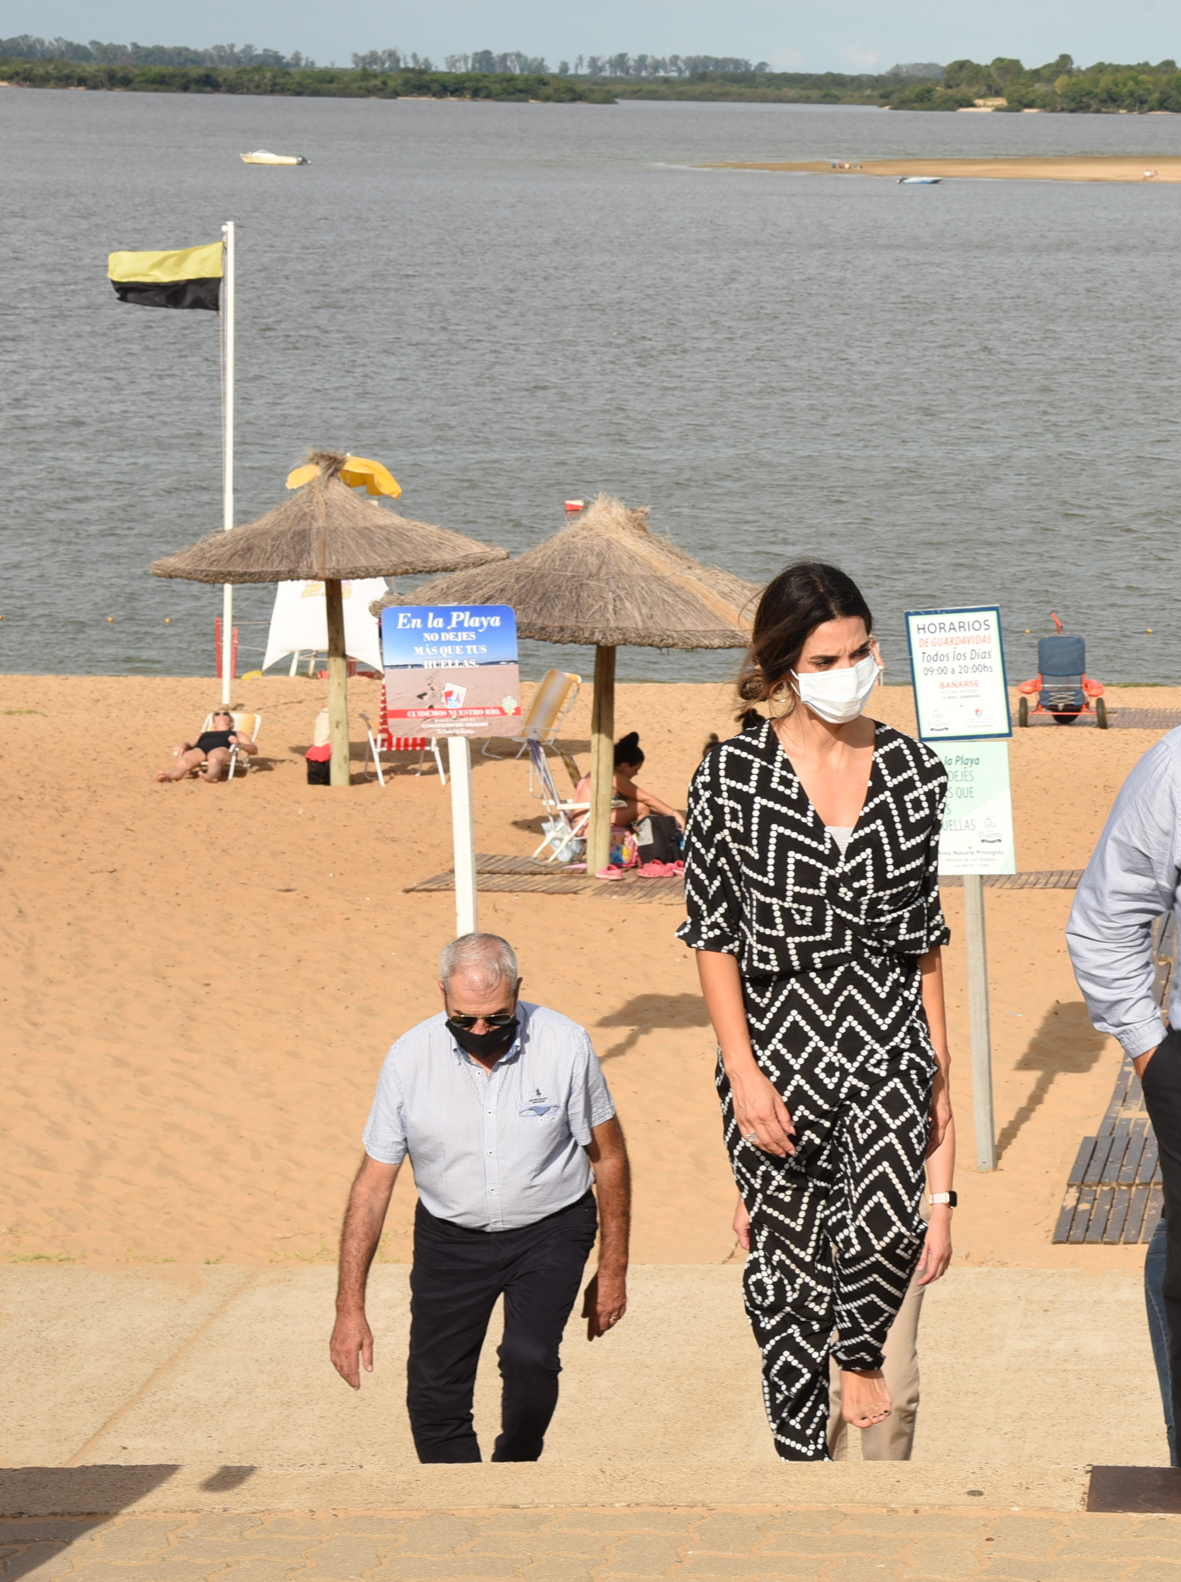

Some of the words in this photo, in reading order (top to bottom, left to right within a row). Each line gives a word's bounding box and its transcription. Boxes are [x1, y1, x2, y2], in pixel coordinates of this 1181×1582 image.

[396, 613, 422, 629] En
[428, 612, 444, 628] la
[449, 611, 501, 632] Playa
[916, 619, 991, 635] HORARIOS
[423, 633, 439, 642] NO
[441, 631, 476, 642] DEJES
[918, 637, 930, 648] DE
[931, 634, 992, 647] GUARDAVIDAS
[414, 643, 438, 655] MÁS
[440, 645, 464, 657] QUE
[465, 645, 487, 654] TUS
[921, 651, 950, 663] Todos
[952, 650, 967, 661] los
[970, 648, 992, 660] Días
[923, 666, 948, 676] 09:00
[950, 667, 956, 675] a
[958, 663, 993, 674] 20:00hs
[939, 679, 980, 689] BAÑARSE
[407, 709, 447, 718] CUIDEMOS
[448, 709, 484, 718] NUESTRO
[944, 755, 953, 766] la
[955, 756, 980, 768] Playa
[955, 787, 975, 799] QUE
[942, 819, 976, 831] UELLAS
